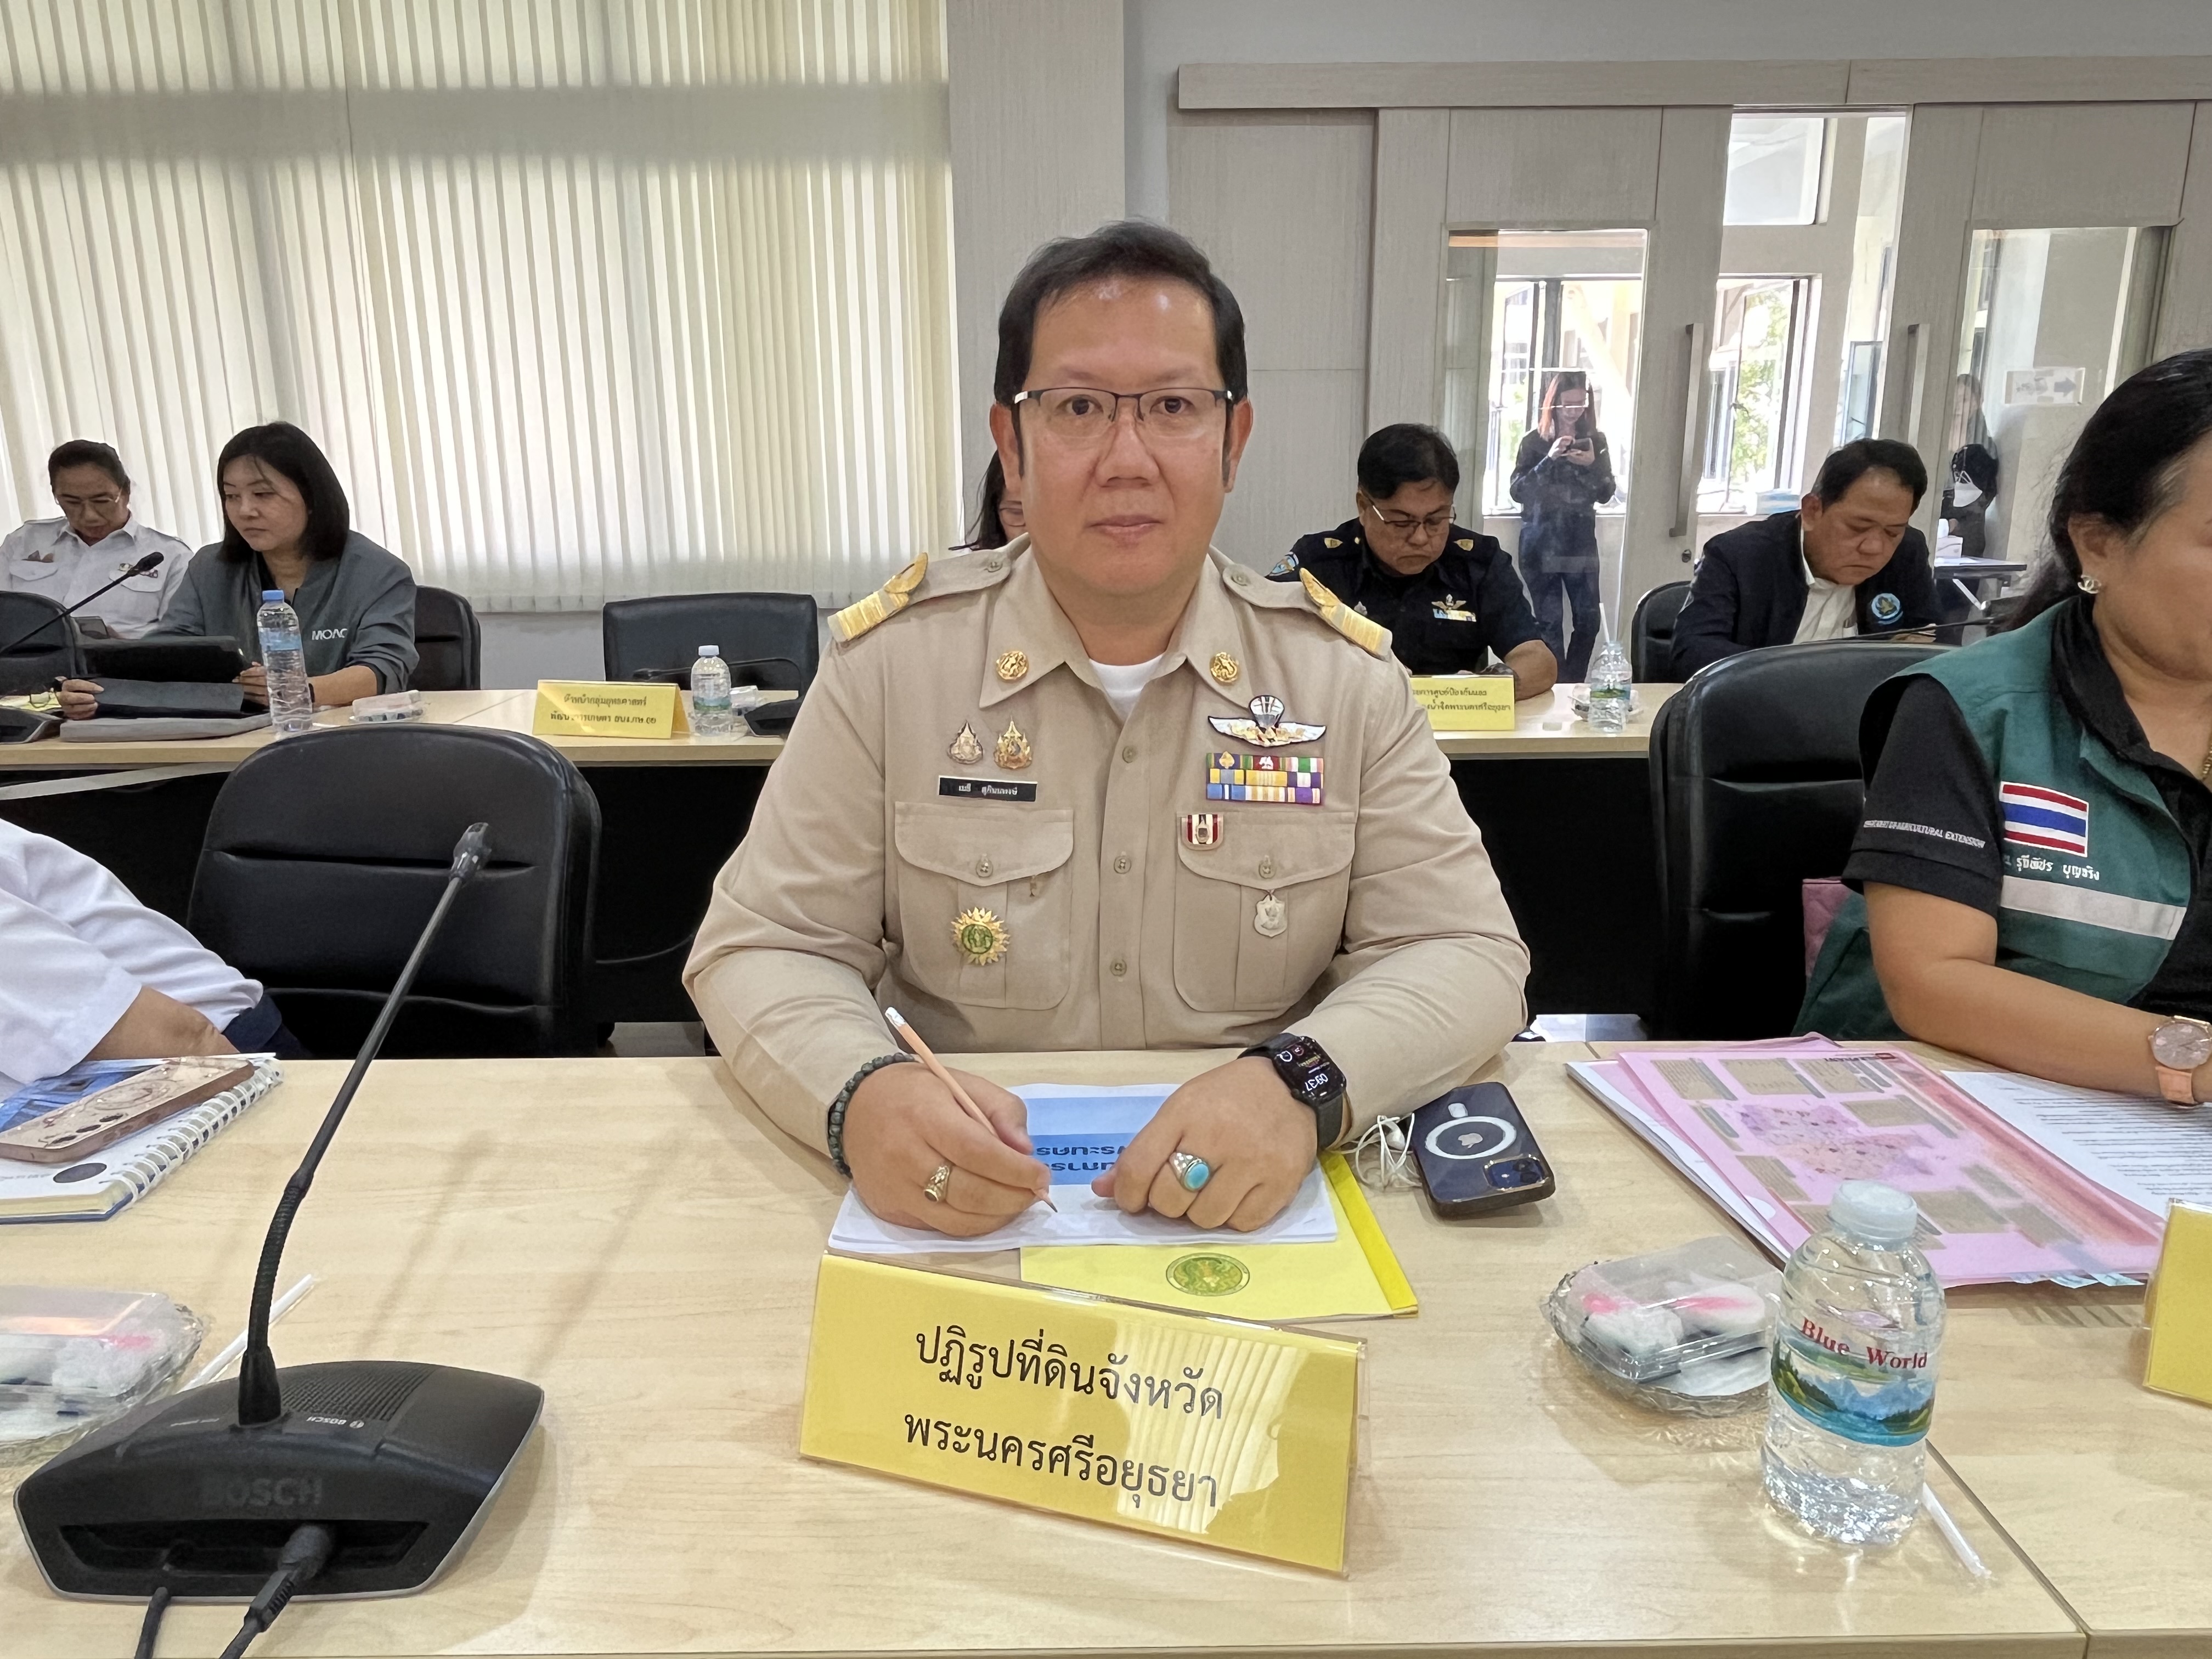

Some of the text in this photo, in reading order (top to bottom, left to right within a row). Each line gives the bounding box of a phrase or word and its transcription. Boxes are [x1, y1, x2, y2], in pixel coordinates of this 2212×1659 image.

[311, 628, 348, 641] MOAC
[1801, 1317, 1928, 1369] Blue World
[916, 1324, 1223, 1420] ปฏิรูปที่ดินจังหวัด
[306, 1415, 347, 1425] BOSCH
[904, 1414, 1217, 1508] พระนครศรีอยุธยา
